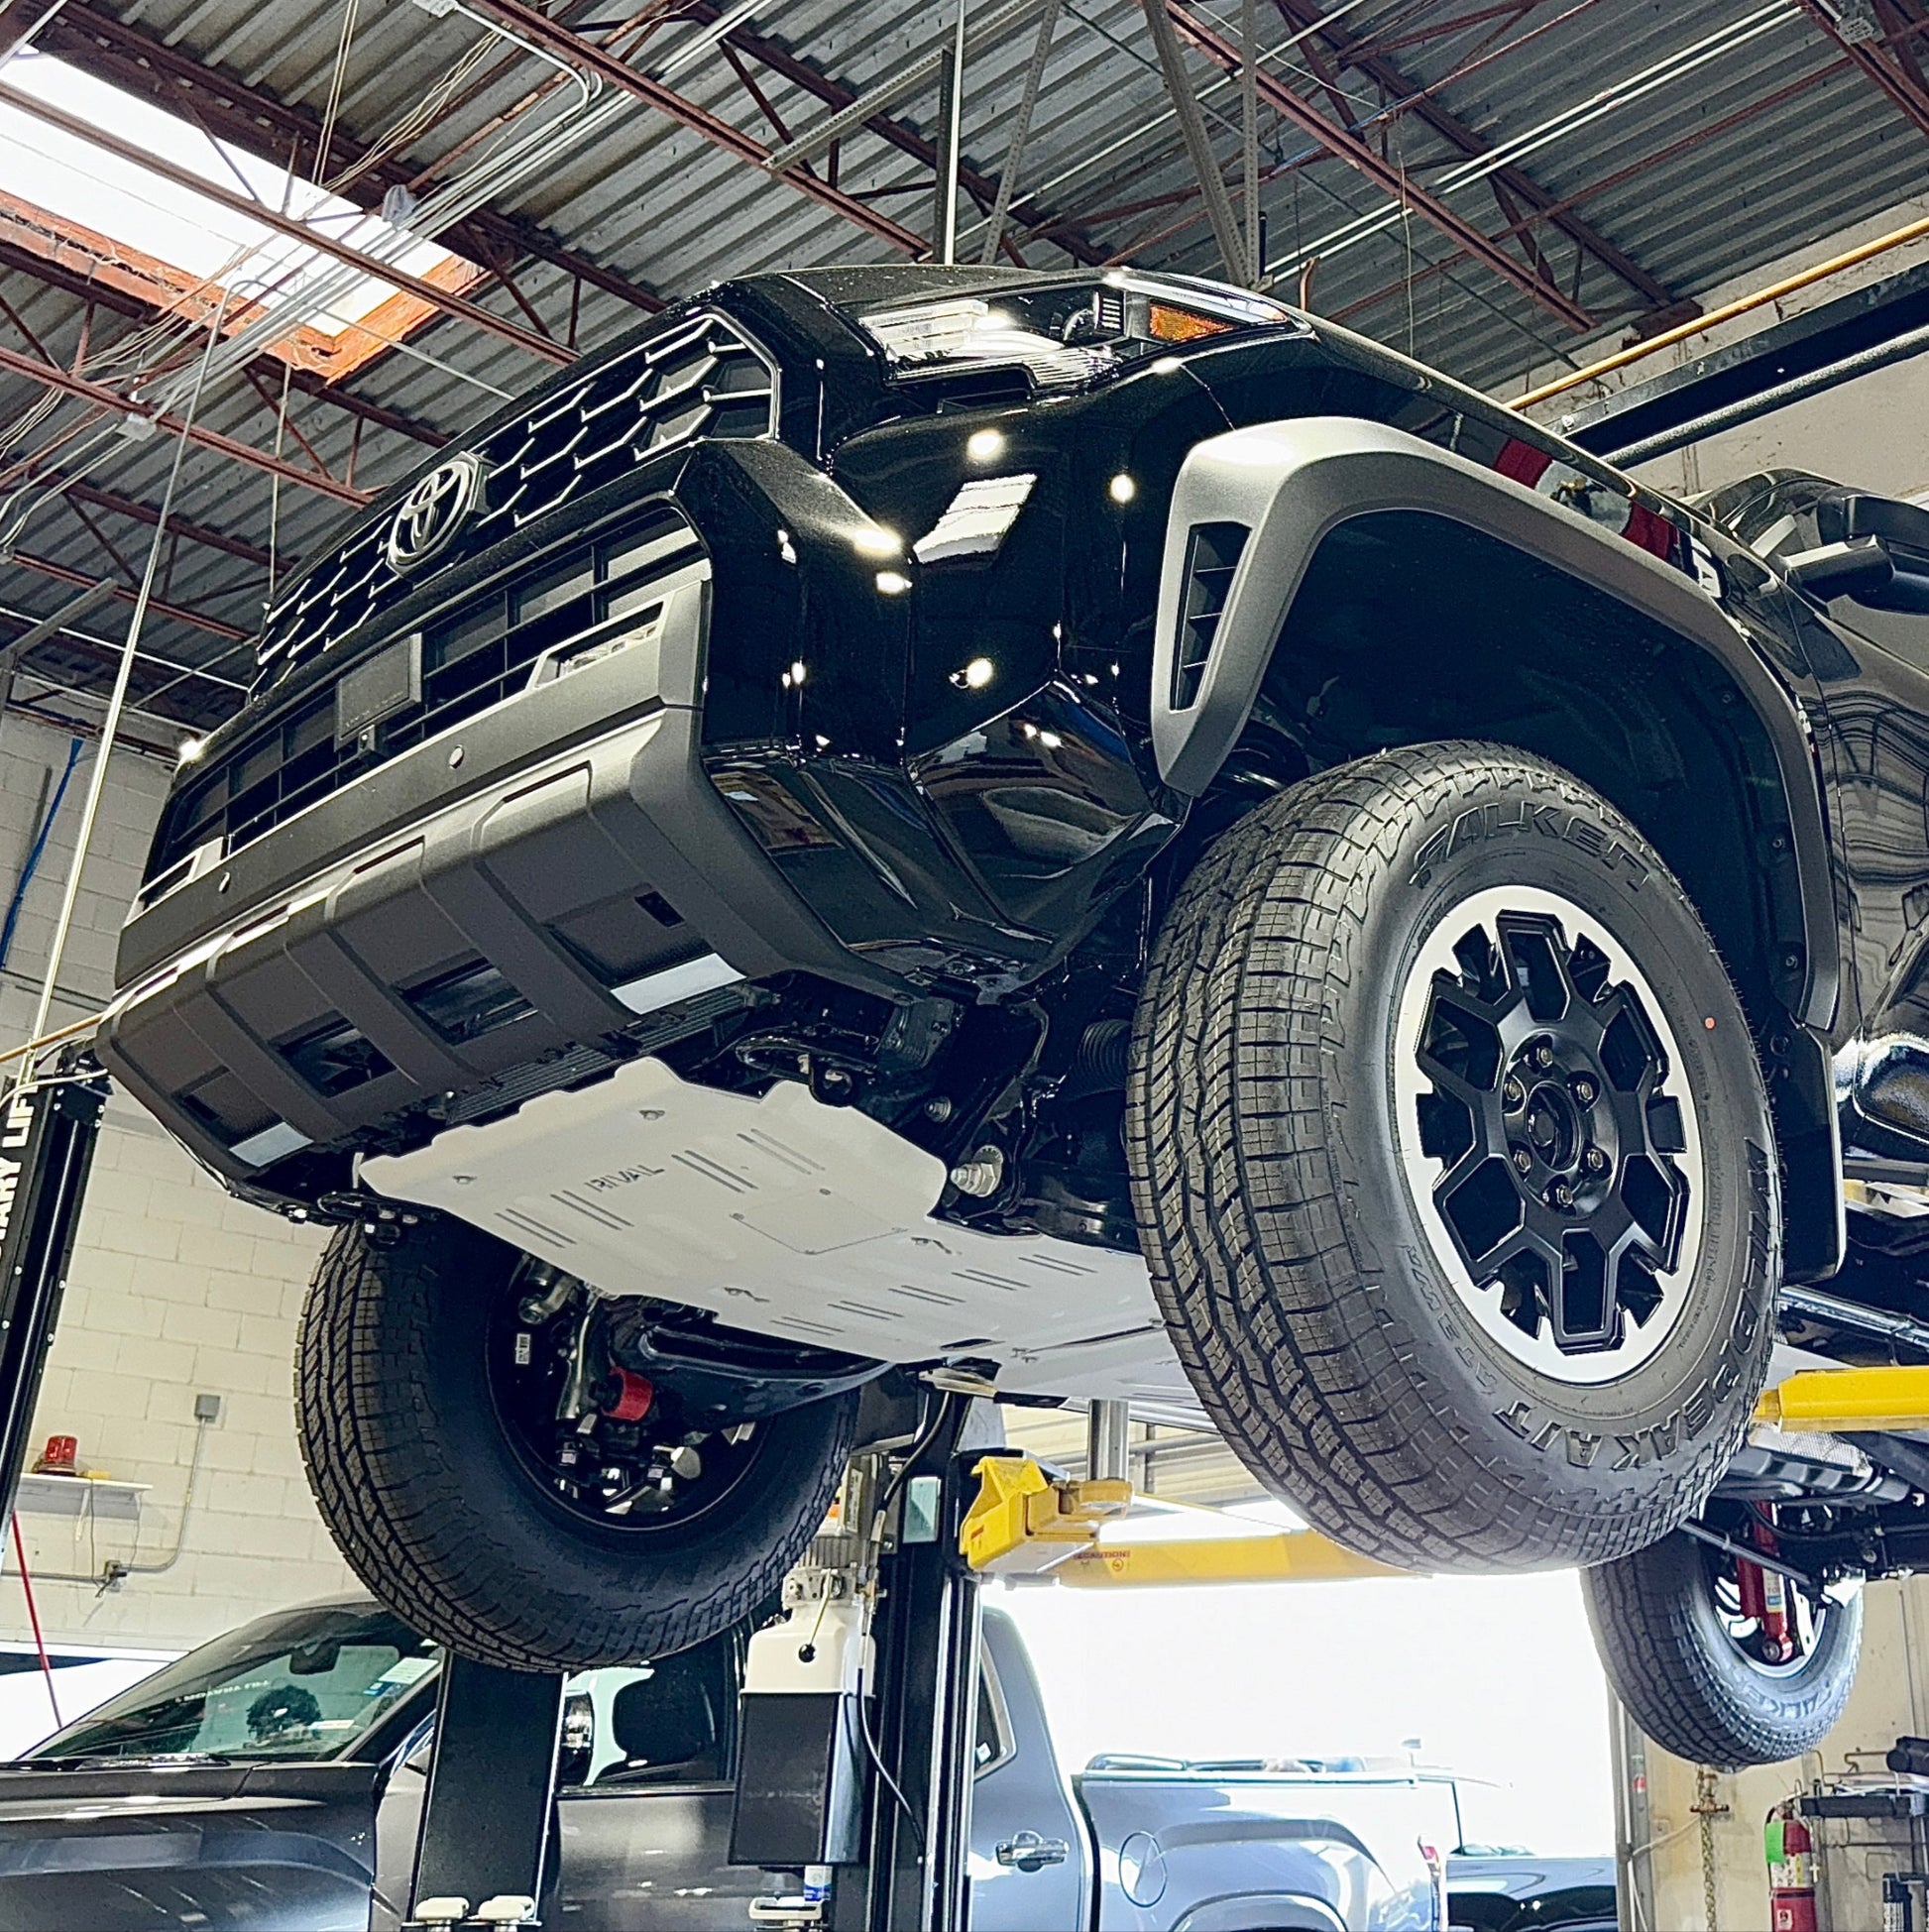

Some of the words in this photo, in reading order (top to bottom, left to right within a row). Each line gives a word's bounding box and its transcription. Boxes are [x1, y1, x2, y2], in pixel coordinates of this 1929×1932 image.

[1409, 800, 1650, 892] FALKEN
[2, 1083, 39, 1148] LIFT
[583, 1164, 664, 1193] RIVAL
[1611, 1137, 1771, 1471] WILDPEAK
